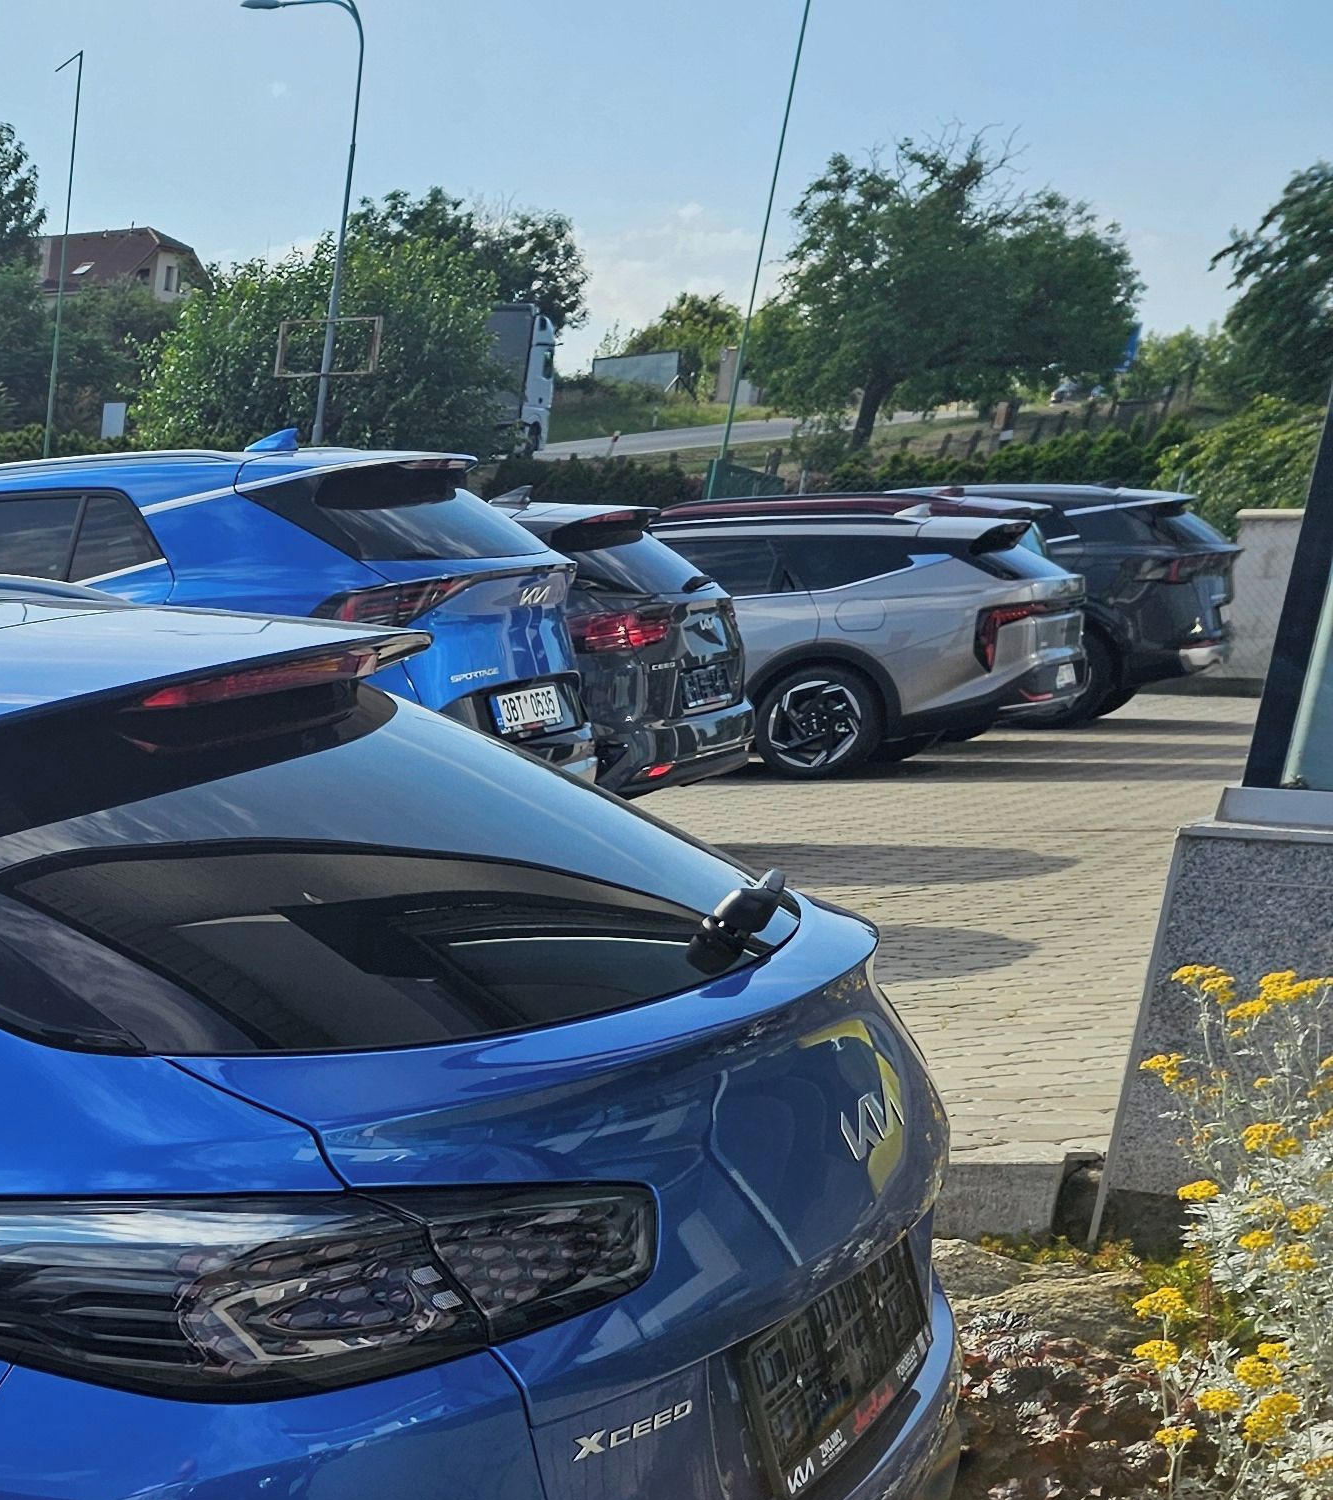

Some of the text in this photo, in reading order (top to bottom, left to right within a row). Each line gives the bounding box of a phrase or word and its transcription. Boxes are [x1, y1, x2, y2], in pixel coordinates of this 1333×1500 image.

[519, 585, 552, 606] KIA
[450, 666, 500, 683] SPORTAGE
[501, 690, 556, 723] 3BT 0535
[840, 1080, 904, 1161] KIA
[573, 1399, 693, 1462] XCEED
[787, 1457, 815, 1495] KIA
